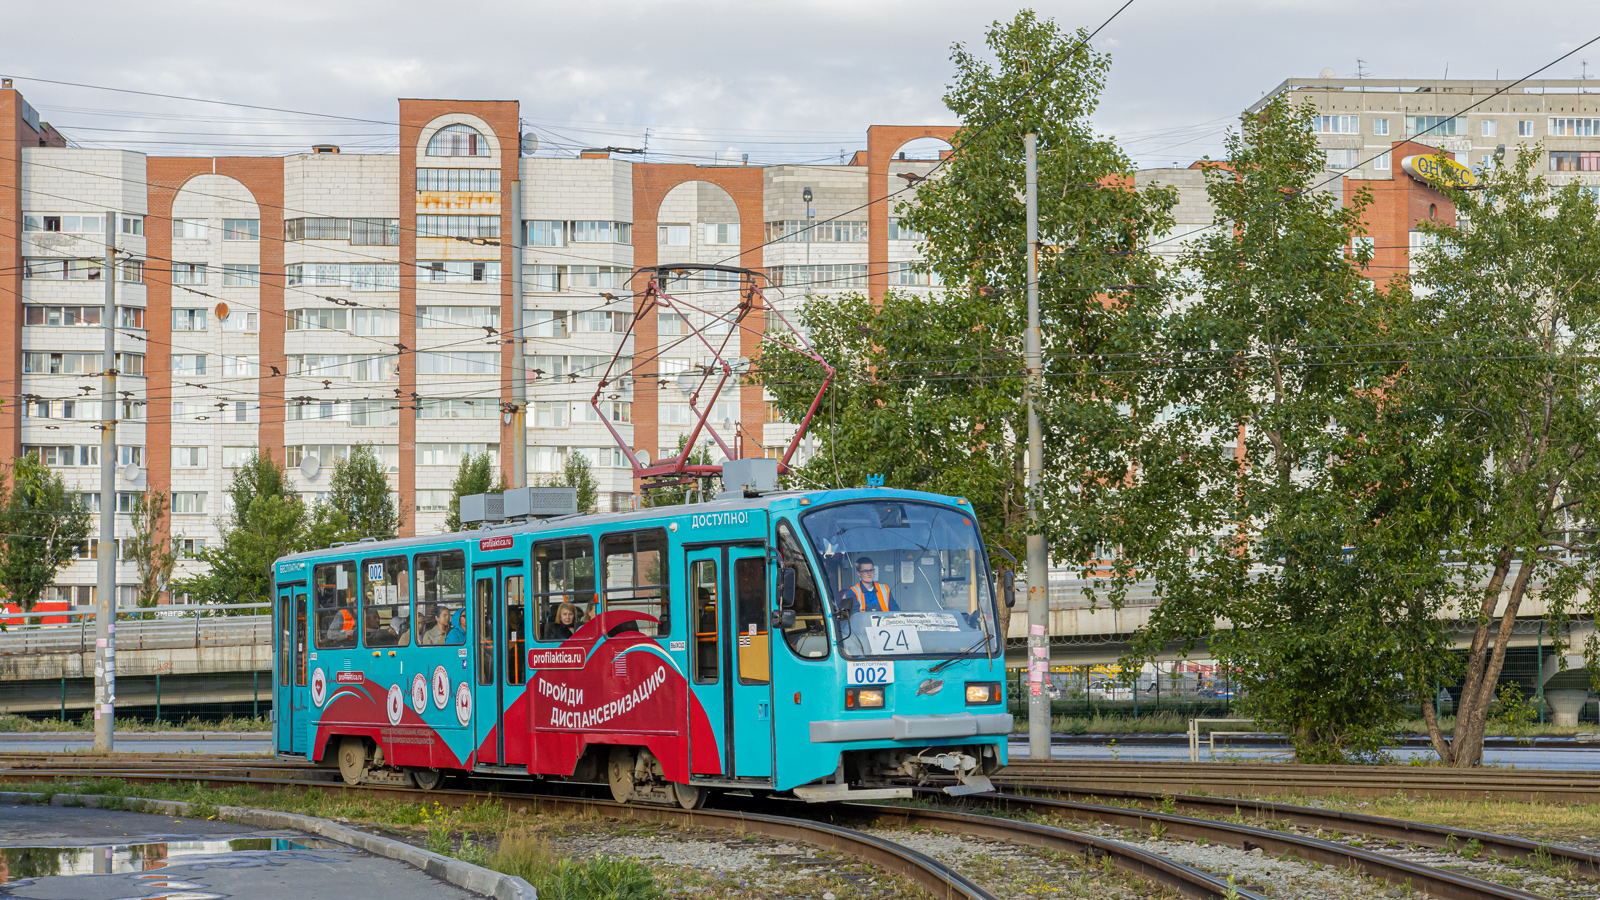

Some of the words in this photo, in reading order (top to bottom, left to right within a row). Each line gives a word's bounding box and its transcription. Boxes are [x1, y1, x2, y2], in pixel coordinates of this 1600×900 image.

[691, 511, 749, 529] ДОСТУПНО!
[482, 539, 512, 550] profilaktica.ru
[370, 565, 382, 580] 002
[376, 589, 382, 604] 24
[872, 616, 881, 627] 7
[670, 642, 685, 650] ВЫХОД
[879, 629, 909, 651] 24
[533, 650, 582, 666] profilaktica.ru
[855, 667, 887, 684] 002
[538, 678, 584, 708] ПРОЙДИ
[550, 665, 666, 728] ДИСПАНСЕРИЗАЦИЮ
